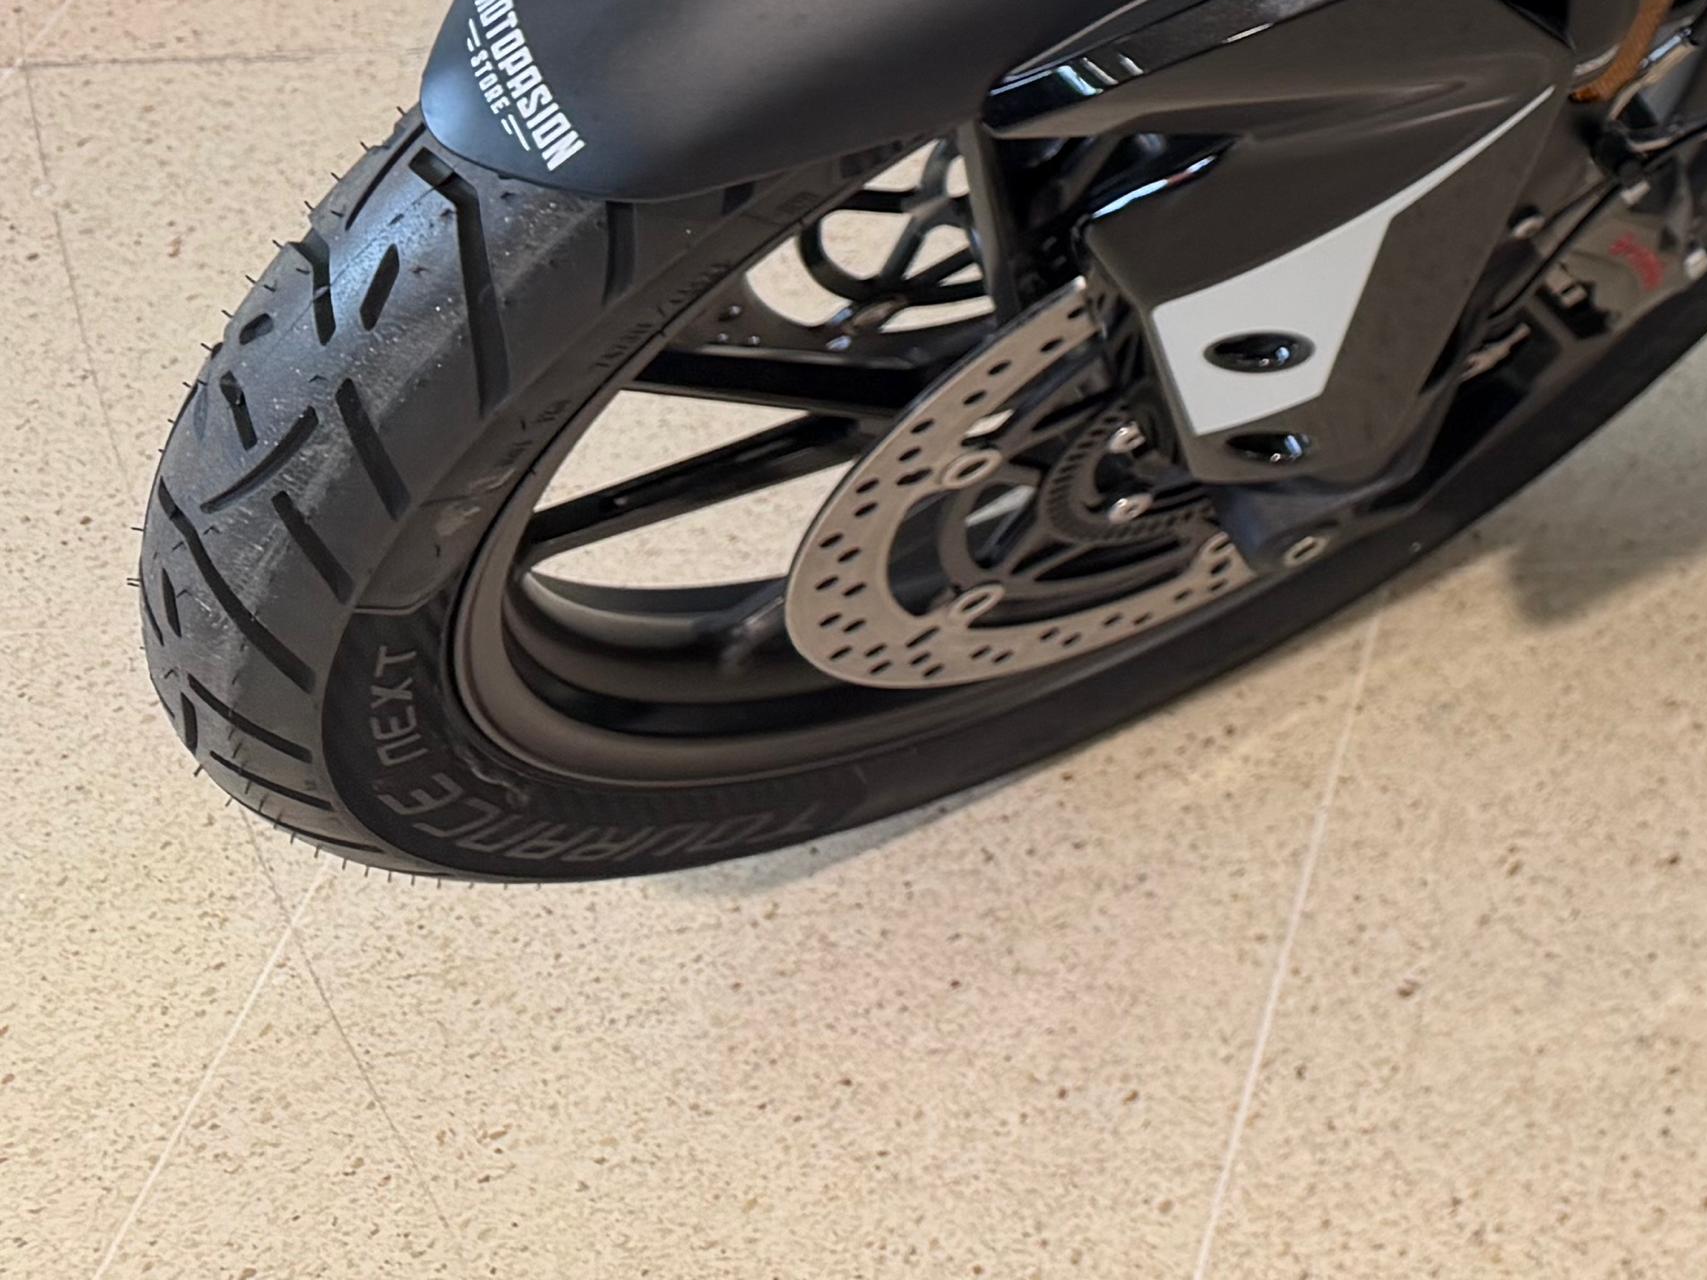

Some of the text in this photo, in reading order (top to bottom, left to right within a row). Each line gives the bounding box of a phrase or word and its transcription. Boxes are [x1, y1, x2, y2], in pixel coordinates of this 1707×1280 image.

[470, 49, 511, 115] STORE
[369, 643, 822, 863] TOURANCE NEXT
